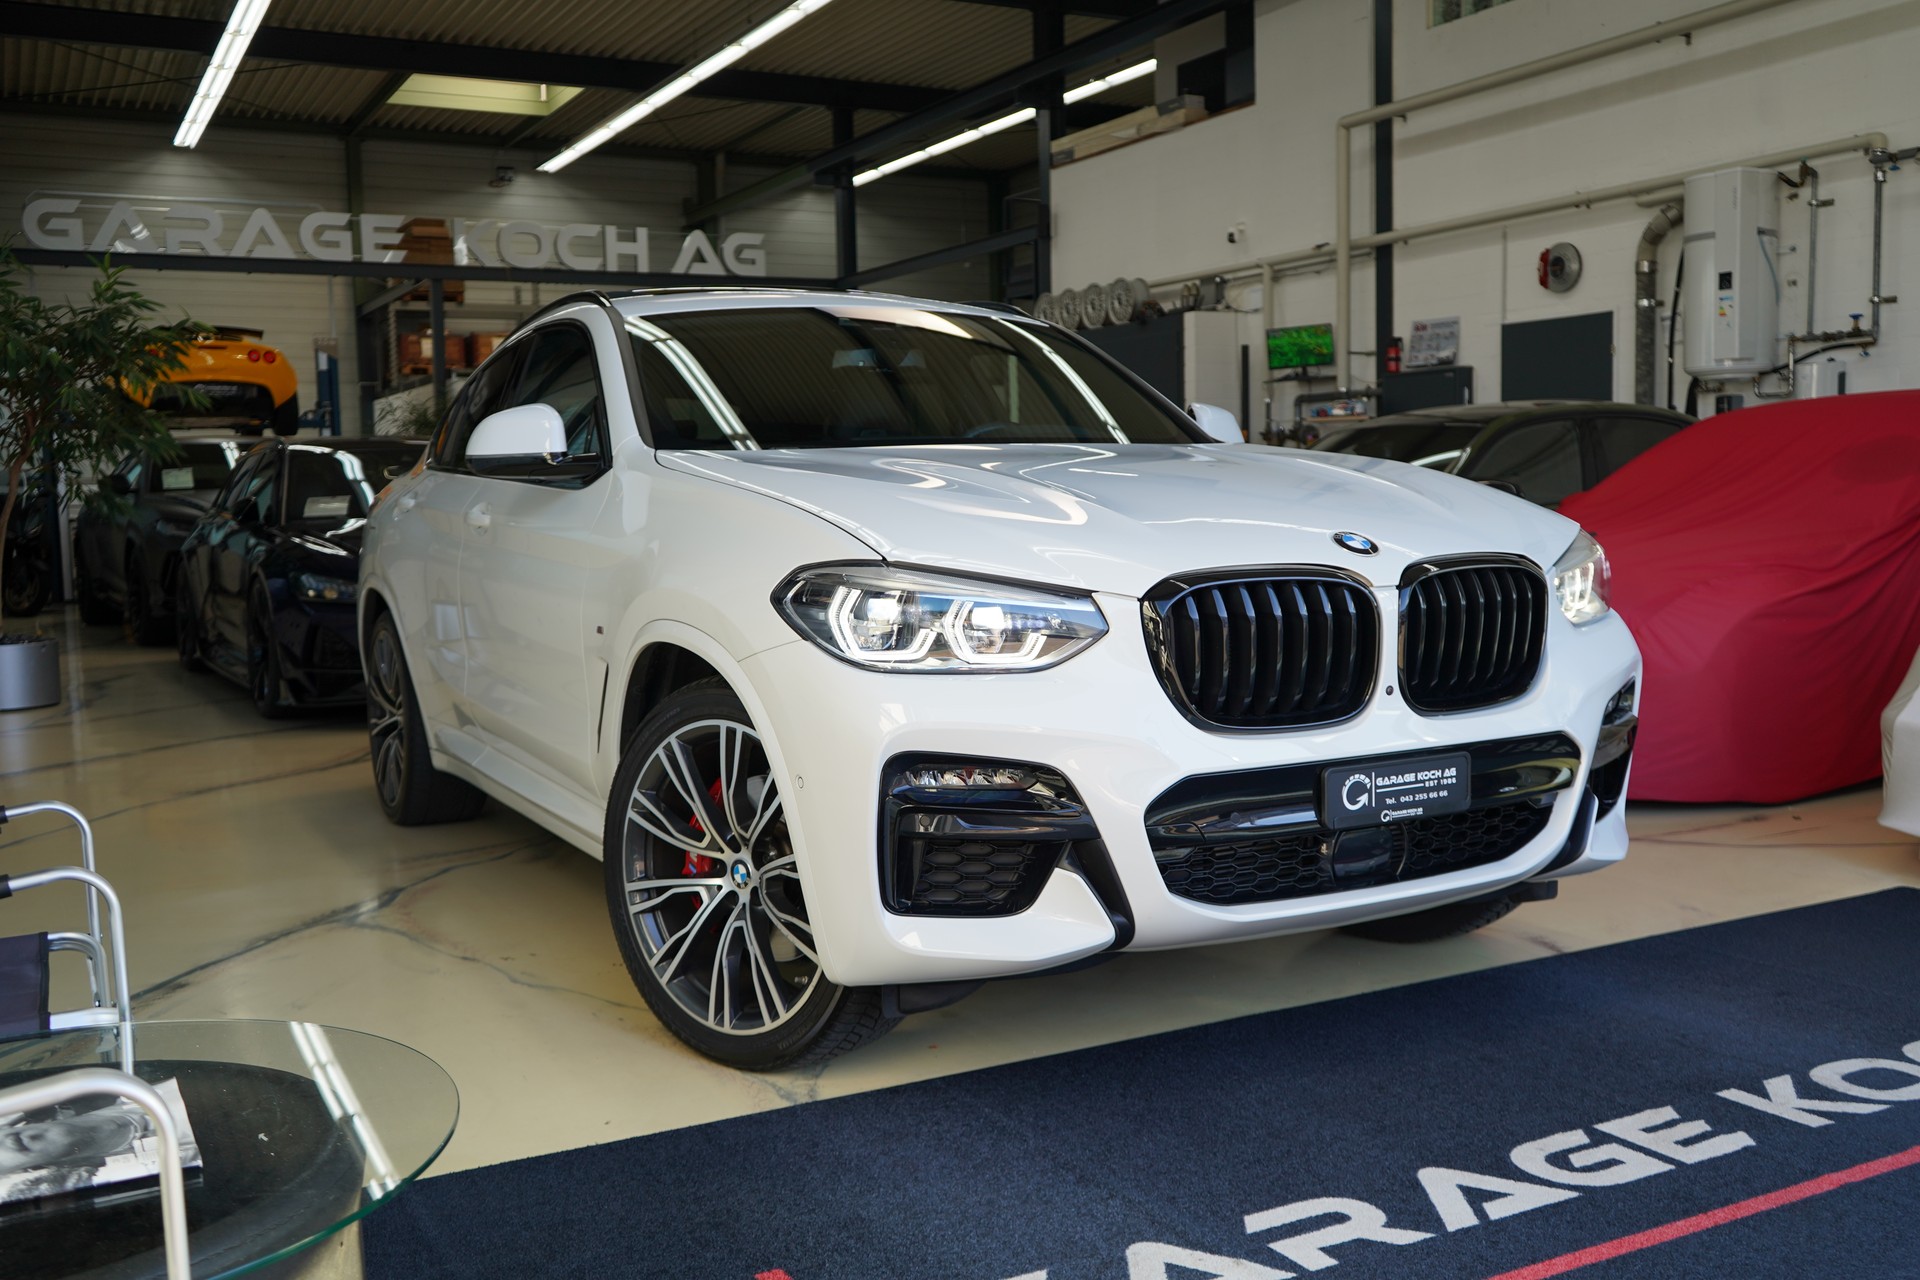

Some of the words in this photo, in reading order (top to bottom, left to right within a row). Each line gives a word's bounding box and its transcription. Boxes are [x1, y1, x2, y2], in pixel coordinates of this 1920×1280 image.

[22, 198, 409, 263] GARAGE
[453, 217, 650, 273] KOCH
[671, 229, 767, 277] AG
[1376, 773, 1416, 786] GARAGE
[1417, 769, 1442, 781] KOCH
[1443, 767, 1457, 778] AG
[1425, 780, 1438, 788] EST
[1385, 797, 1397, 805] Tel.
[1400, 794, 1413, 803] 043
[1414, 793, 1428, 801] 255
[1428, 791, 1438, 799] 66
[1439, 790, 1448, 798] 66
[998, 1105, 1756, 1280] ARAGE
[1715, 1040, 1920, 1128] KO
